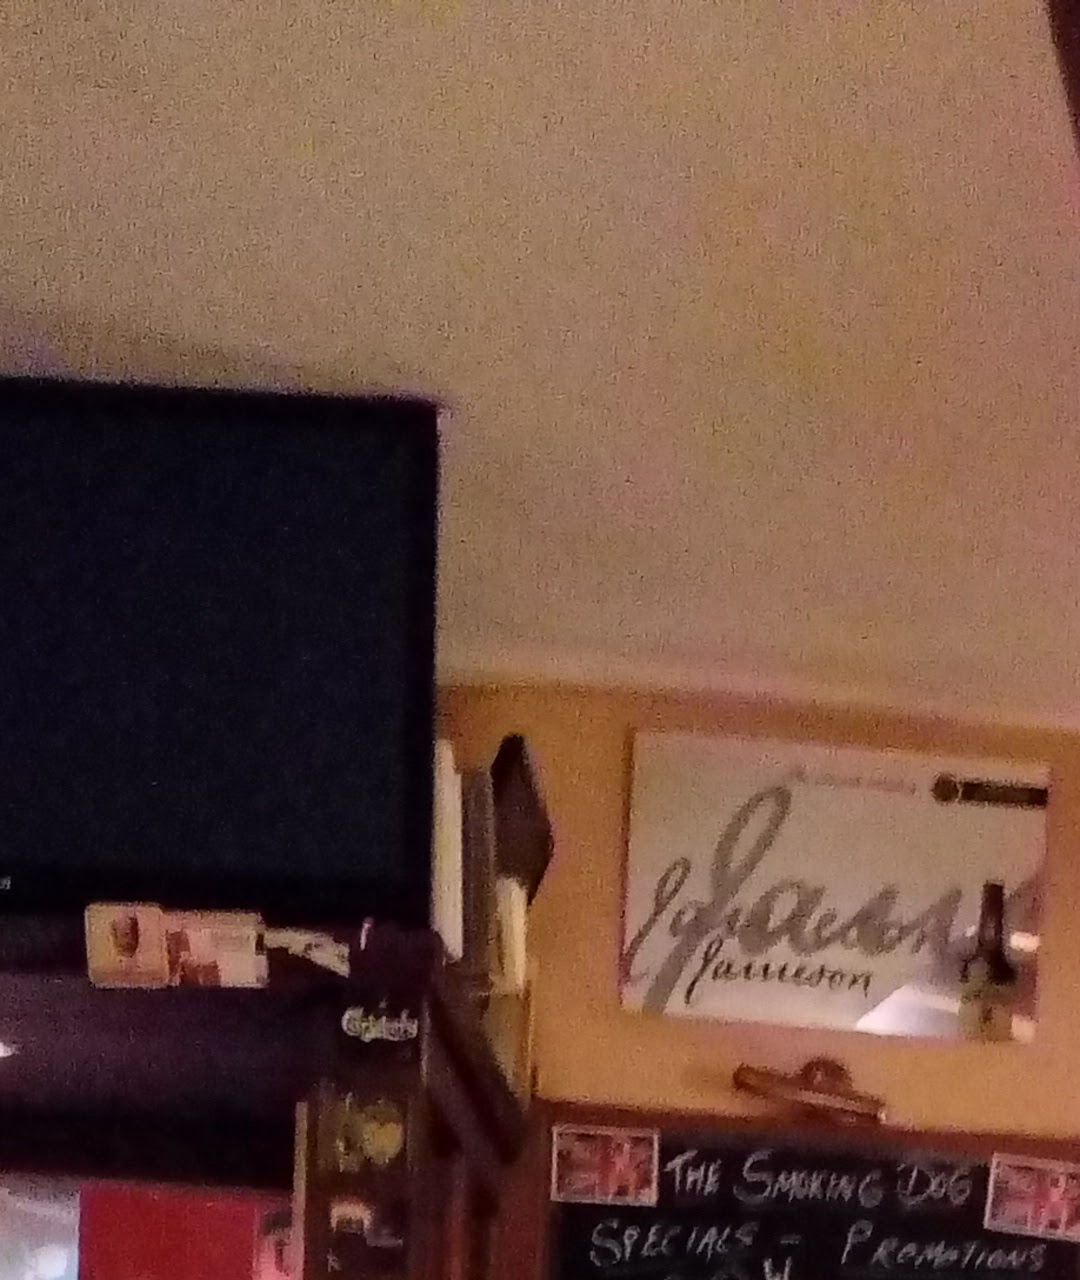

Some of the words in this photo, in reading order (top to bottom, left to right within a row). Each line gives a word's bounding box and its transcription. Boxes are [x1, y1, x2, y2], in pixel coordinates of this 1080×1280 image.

[684, 938, 874, 1004] Jameson
[737, 1149, 884, 1208] SMOKING
[896, 1161, 973, 1206] DOG
